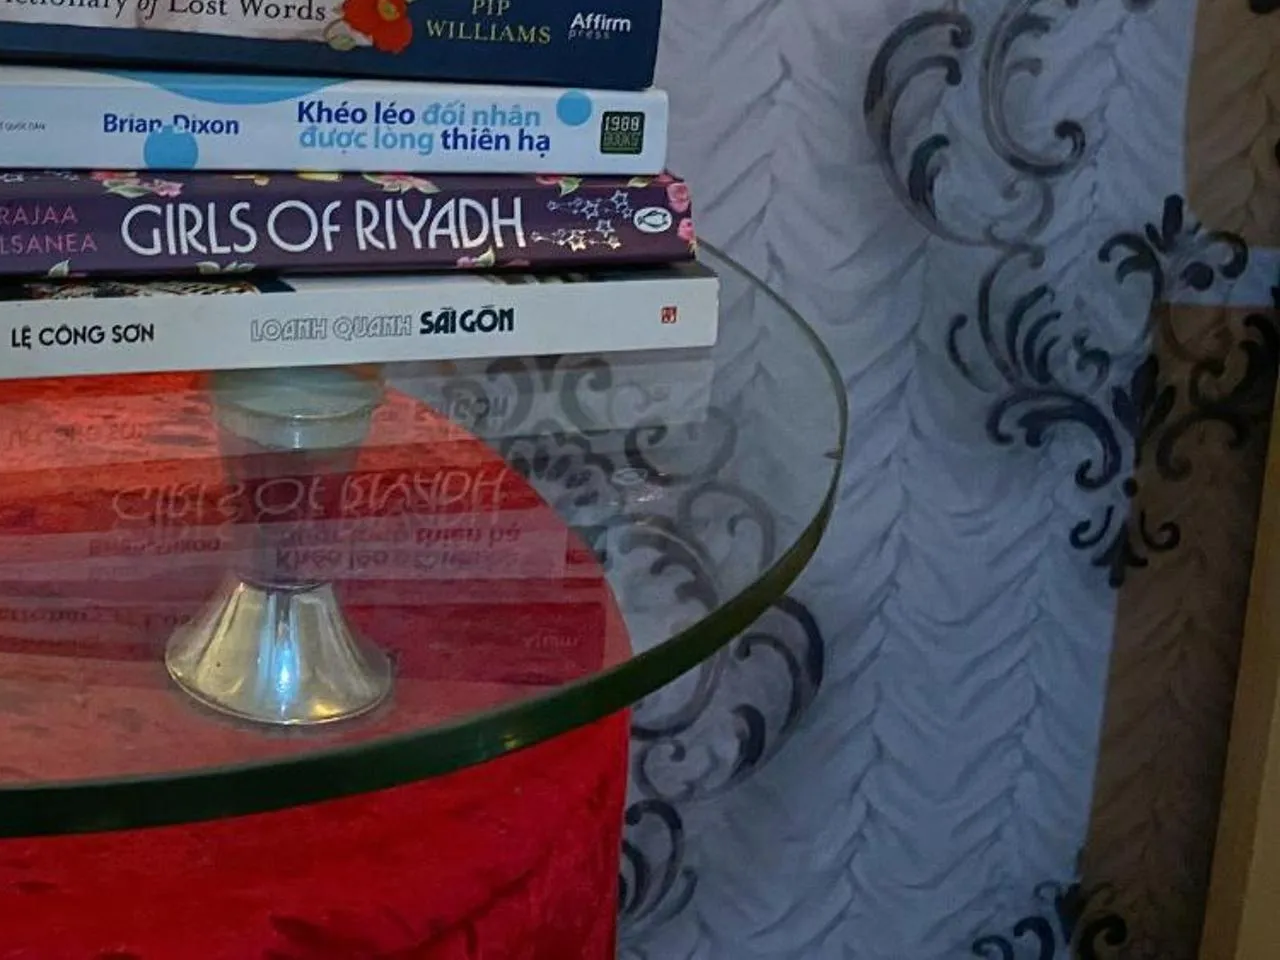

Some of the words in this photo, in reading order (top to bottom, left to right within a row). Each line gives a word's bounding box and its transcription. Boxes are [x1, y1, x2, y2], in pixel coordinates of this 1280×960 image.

[426, 19, 552, 44] WILLIAMS
[570, 11, 632, 33] Affirm
[103, 112, 162, 134] Brian
[173, 113, 240, 135] Dixon
[297, 100, 367, 125] Khéo
[374, 100, 416, 125] léo
[422, 99, 466, 126] đối
[299, 125, 368, 154] được
[374, 125, 435, 156] lòng
[441, 127, 511, 152] thiên
[518, 128, 551, 158] hạ
[121, 201, 258, 257] GIRLS
[266, 198, 343, 253] OF
[355, 196, 525, 250] RIYADH
[39, 323, 106, 346] CÔNG
[112, 322, 155, 344] SƠN
[250, 317, 328, 343] LOANH
[332, 314, 413, 342] QUANH
